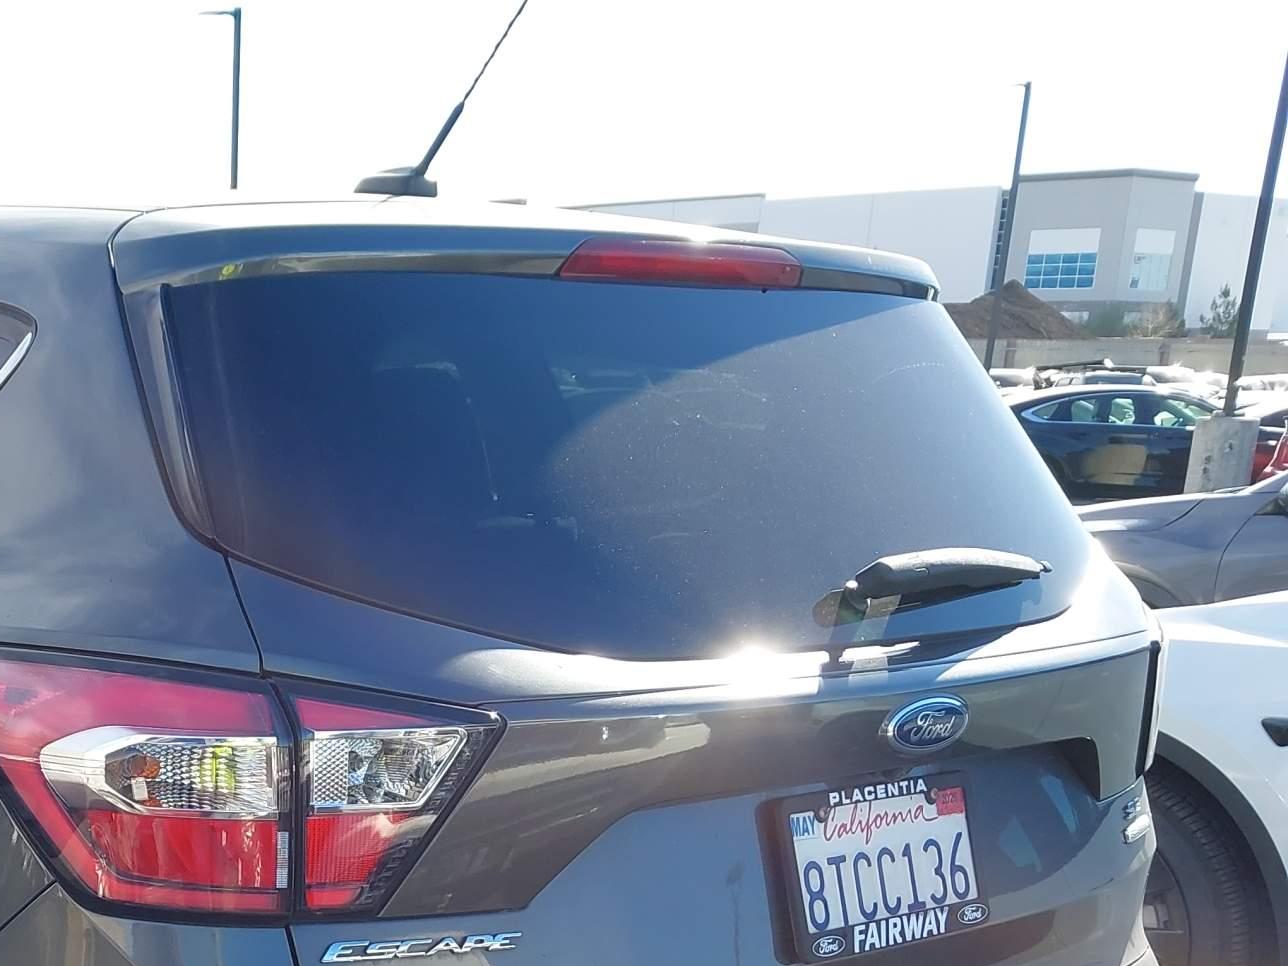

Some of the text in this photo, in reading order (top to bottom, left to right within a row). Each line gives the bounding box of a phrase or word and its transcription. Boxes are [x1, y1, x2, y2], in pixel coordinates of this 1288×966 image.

[910, 710, 956, 740] Ford
[828, 778, 928, 807] PLACENTIA
[791, 814, 817, 838] MAY
[823, 802, 939, 846] California
[803, 831, 971, 932] 8TCC136
[818, 906, 983, 955] Ford FAIRWAY Ford
[320, 932, 522, 963] ESCAPE
